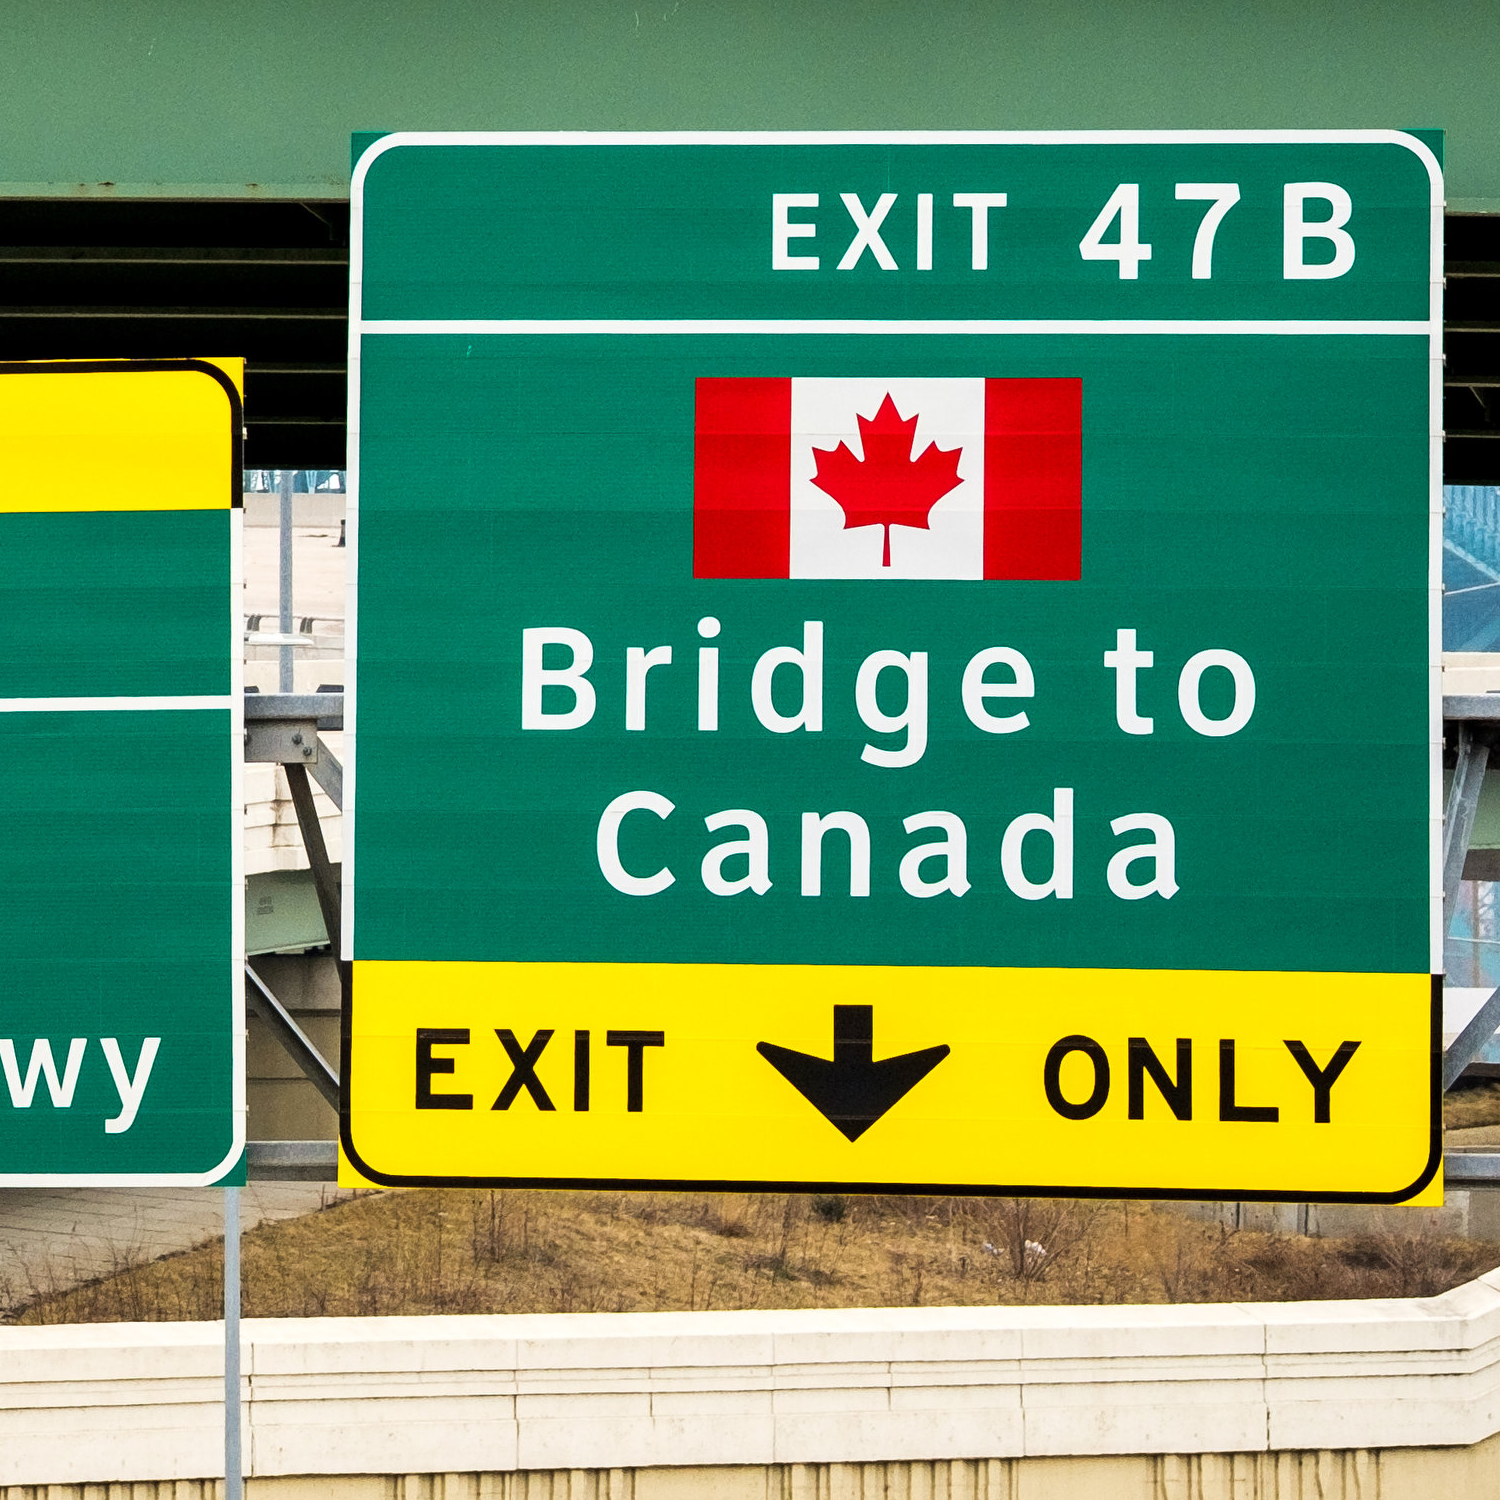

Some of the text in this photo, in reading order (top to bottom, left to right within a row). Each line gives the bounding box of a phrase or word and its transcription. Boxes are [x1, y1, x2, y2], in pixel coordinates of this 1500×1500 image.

[771, 192, 1008, 271] EXIT
[520, 616, 1257, 768] Bridge to
[595, 787, 1181, 901] Canada
[414, 1027, 1362, 1125] EXIT ONLY
